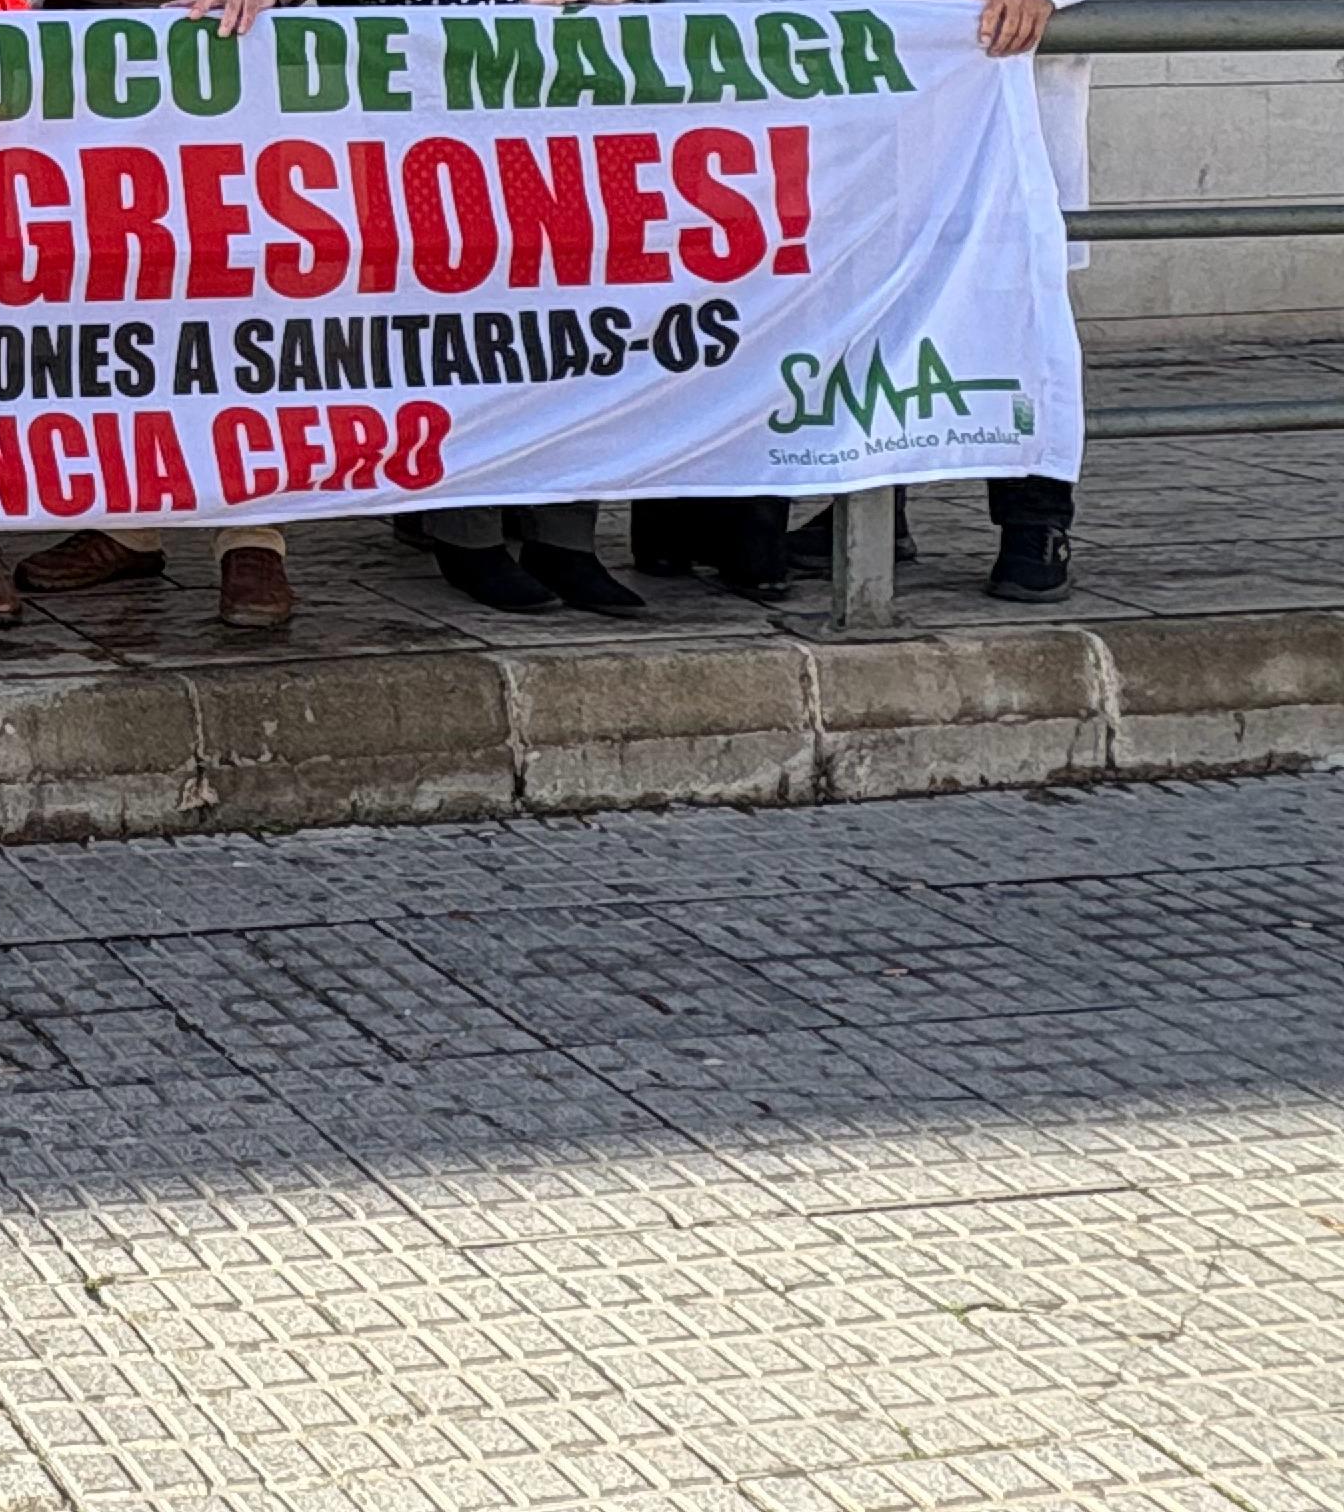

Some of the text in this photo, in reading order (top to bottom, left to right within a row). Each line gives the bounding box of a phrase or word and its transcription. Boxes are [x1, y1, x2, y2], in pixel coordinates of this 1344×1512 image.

[276, 18, 409, 112] DE
[441, 3, 916, 109] MÁLAGA
[174, 321, 218, 395] A
[234, 298, 740, 394] SANITARIAS-OS
[212, 401, 452, 506] CERO
[768, 426, 1022, 467] Sindicato Médico Andaluz
